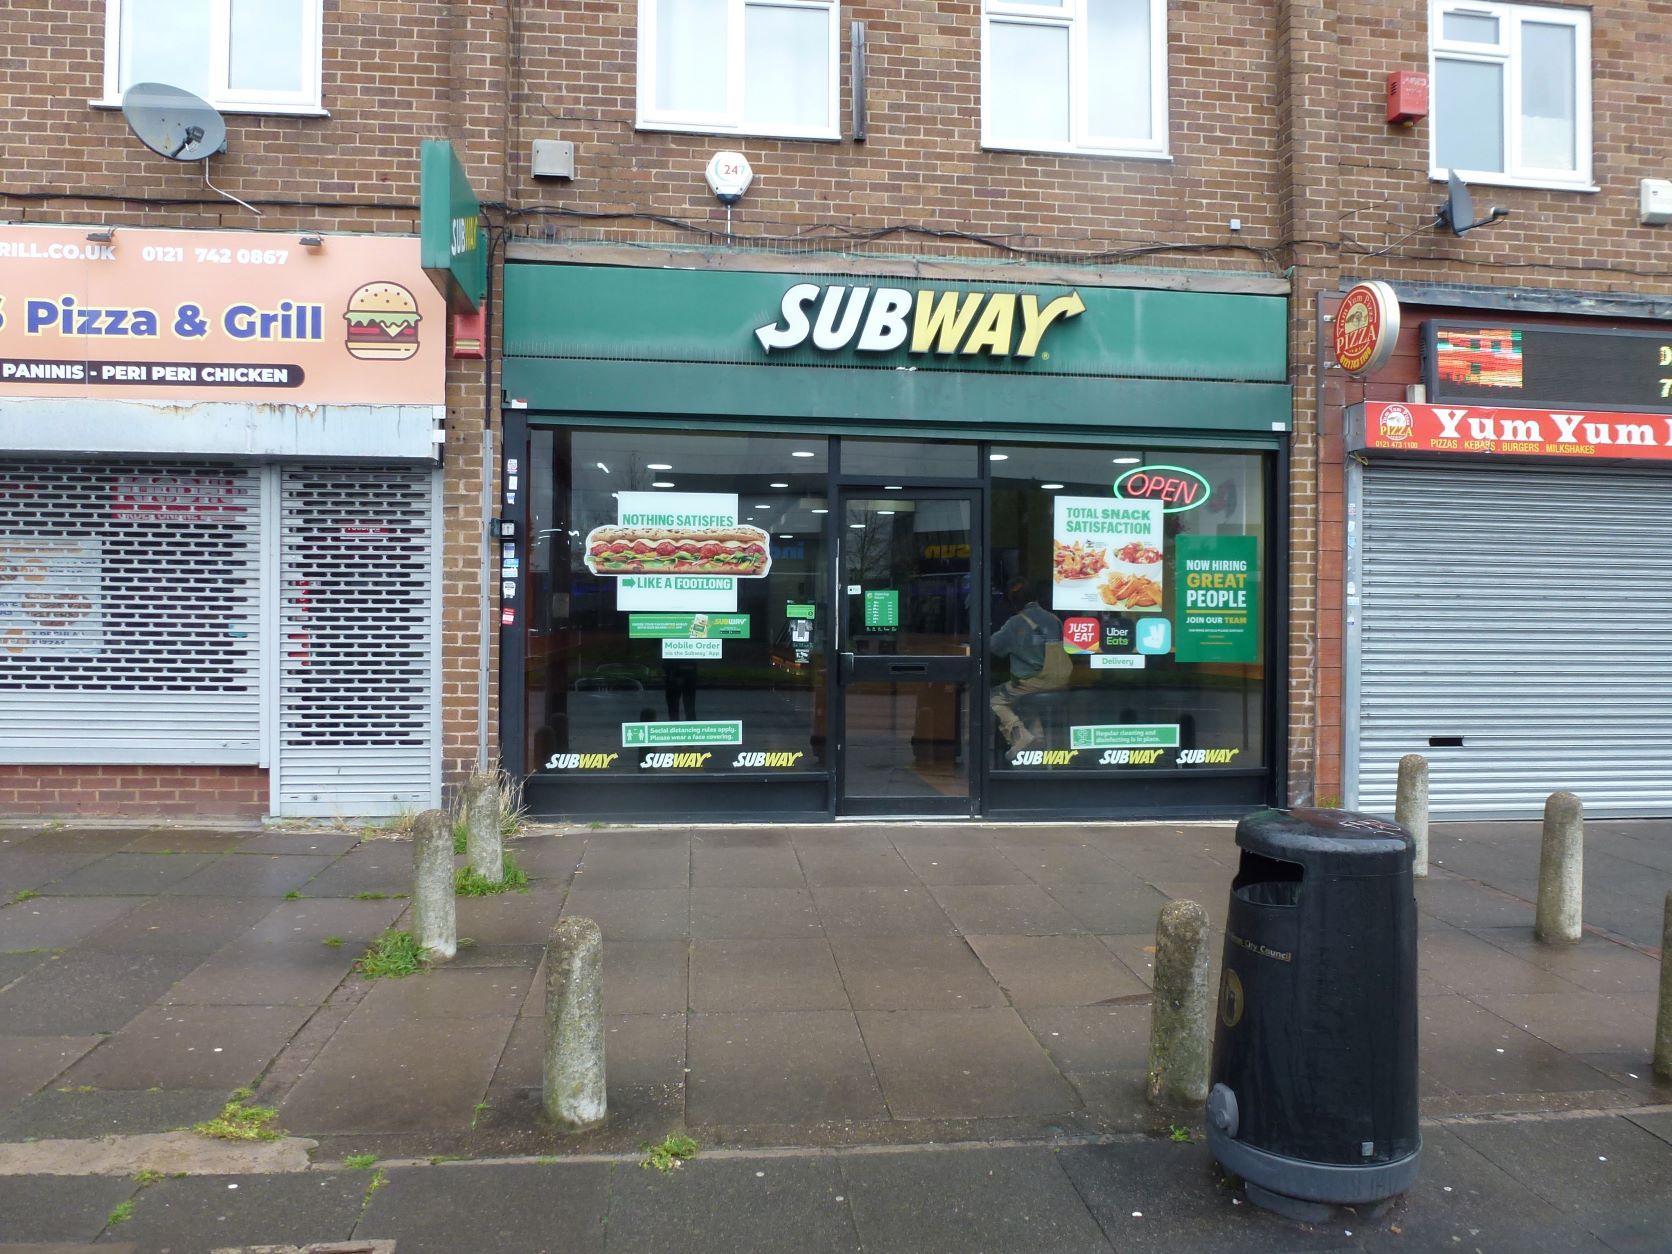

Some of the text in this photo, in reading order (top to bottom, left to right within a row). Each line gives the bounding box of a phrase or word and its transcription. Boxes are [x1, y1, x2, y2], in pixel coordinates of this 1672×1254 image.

[451, 215, 478, 256] SUBWAY
[142, 246, 184, 262] 0121
[195, 248, 232, 264] 742
[236, 249, 289, 265] 0867
[26, 295, 158, 337] Pizza
[173, 303, 209, 338] &
[223, 300, 323, 340] Grill
[753, 283, 1086, 357] SUBWAY
[1336, 325, 1376, 354] PIZZA
[2, 363, 85, 379] PANINIS
[102, 365, 147, 380] PERI
[152, 366, 197, 381] PERI
[201, 367, 288, 382] CHICKEN
[1380, 425, 1413, 437] PIZZA
[1431, 408, 1545, 442] Yum
[1549, 414, 1658, 446] Yum
[1375, 440, 1390, 448] 0121
[1430, 438, 1595, 454] PIZZAS KEBABS BURGERS MILKSHAKES
[1126, 473, 1198, 504] OPEN
[622, 514, 733, 527] NOTHING SATISFIES
[1066, 507, 1151, 521] TOTAL SNACK
[1066, 520, 1151, 535] SATISFACTION
[1186, 560, 1247, 571] NOW HIRING
[637, 577, 731, 589] LIKE A FOOTLONG
[1187, 573, 1247, 588] GREAT
[1186, 590, 1247, 608] PEOPLE
[714, 618, 747, 626] SUBWAY
[1068, 623, 1094, 634] JUST
[1073, 633, 1094, 642] EAT
[1106, 627, 1128, 636] Uber
[1106, 637, 1128, 646] Eats
[1102, 658, 1134, 666] Delivery
[545, 752, 618, 769] SUBWAY
[640, 751, 712, 768] SUBWAY
[732, 750, 803, 767] SUBWAY
[1012, 750, 1079, 766] SUBWAY
[1099, 748, 1165, 765] SUBWAY
[1175, 748, 1240, 765] SUBWAY
[1259, 945, 1291, 960] Council
